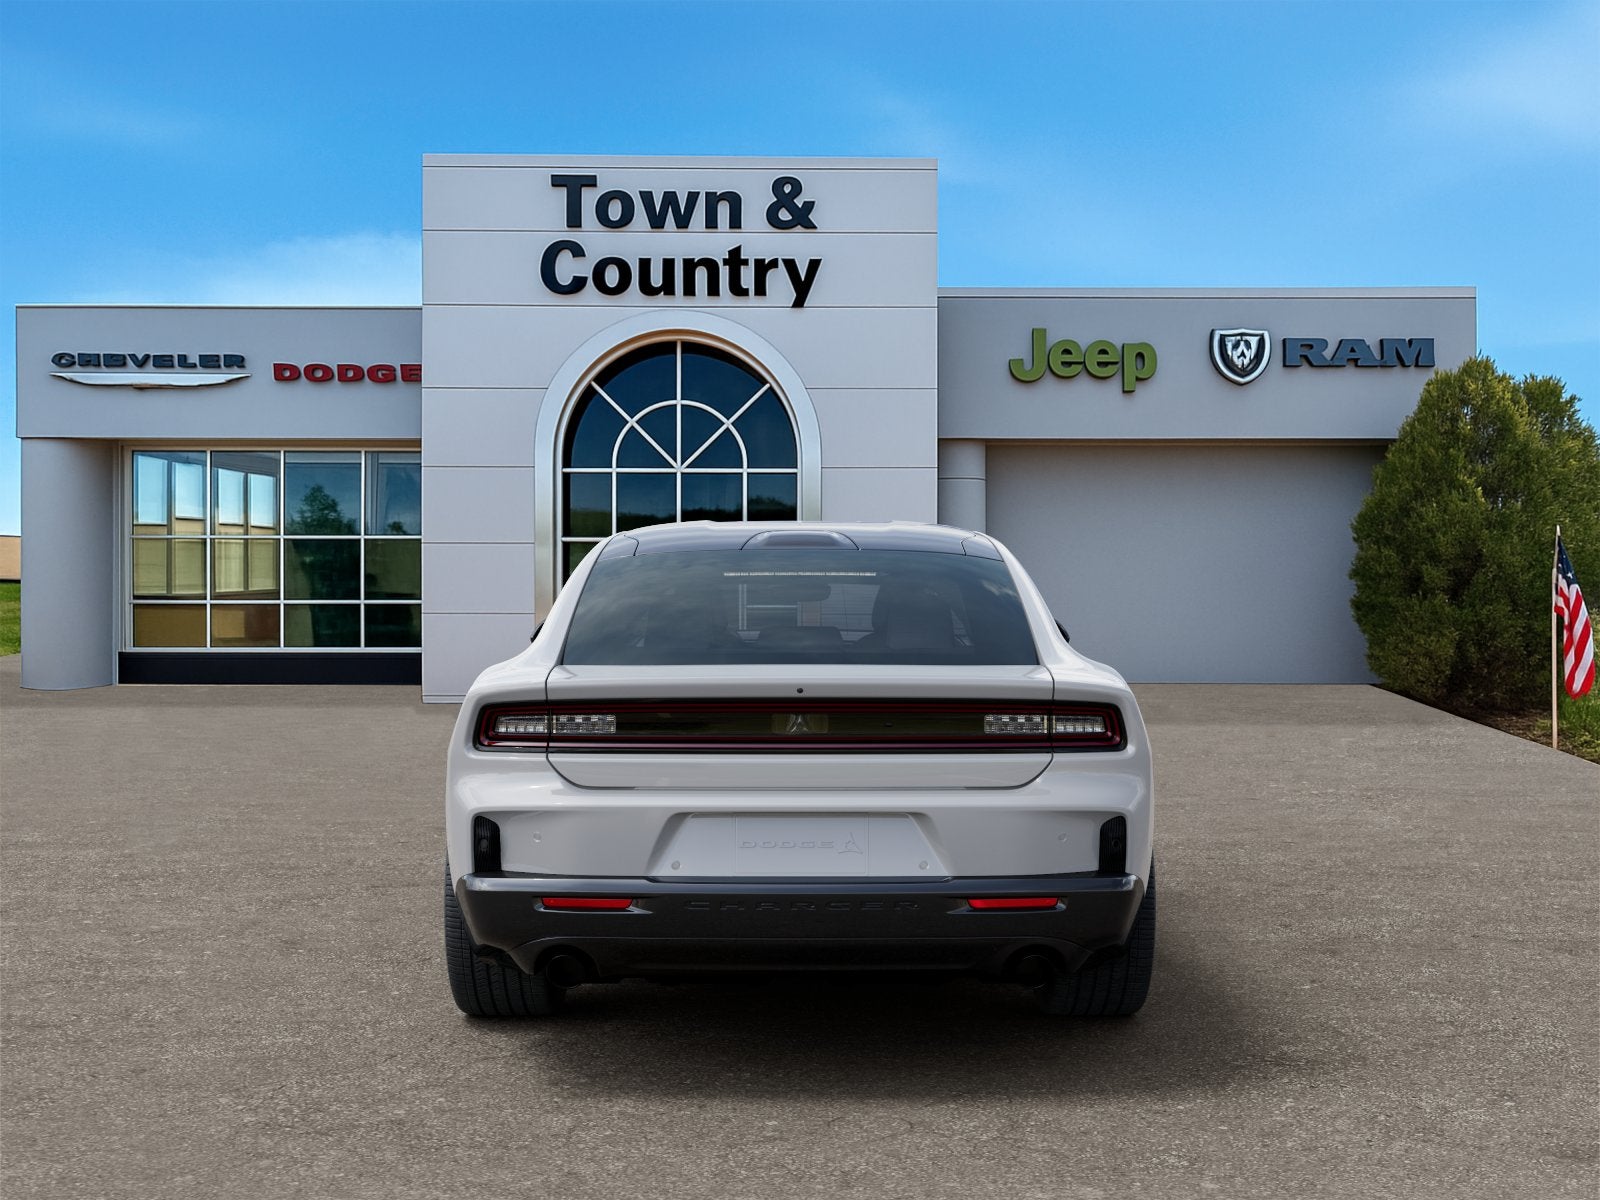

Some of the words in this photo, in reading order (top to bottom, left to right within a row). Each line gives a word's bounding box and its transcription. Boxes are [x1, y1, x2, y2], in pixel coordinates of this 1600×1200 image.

[550, 173, 742, 229] Town
[765, 175, 818, 230] &
[540, 239, 822, 308] Country
[273, 362, 422, 383] DODGE
[1008, 327, 1158, 393] Jeep
[1282, 337, 1435, 367] RAM
[739, 840, 834, 849] DODGE
